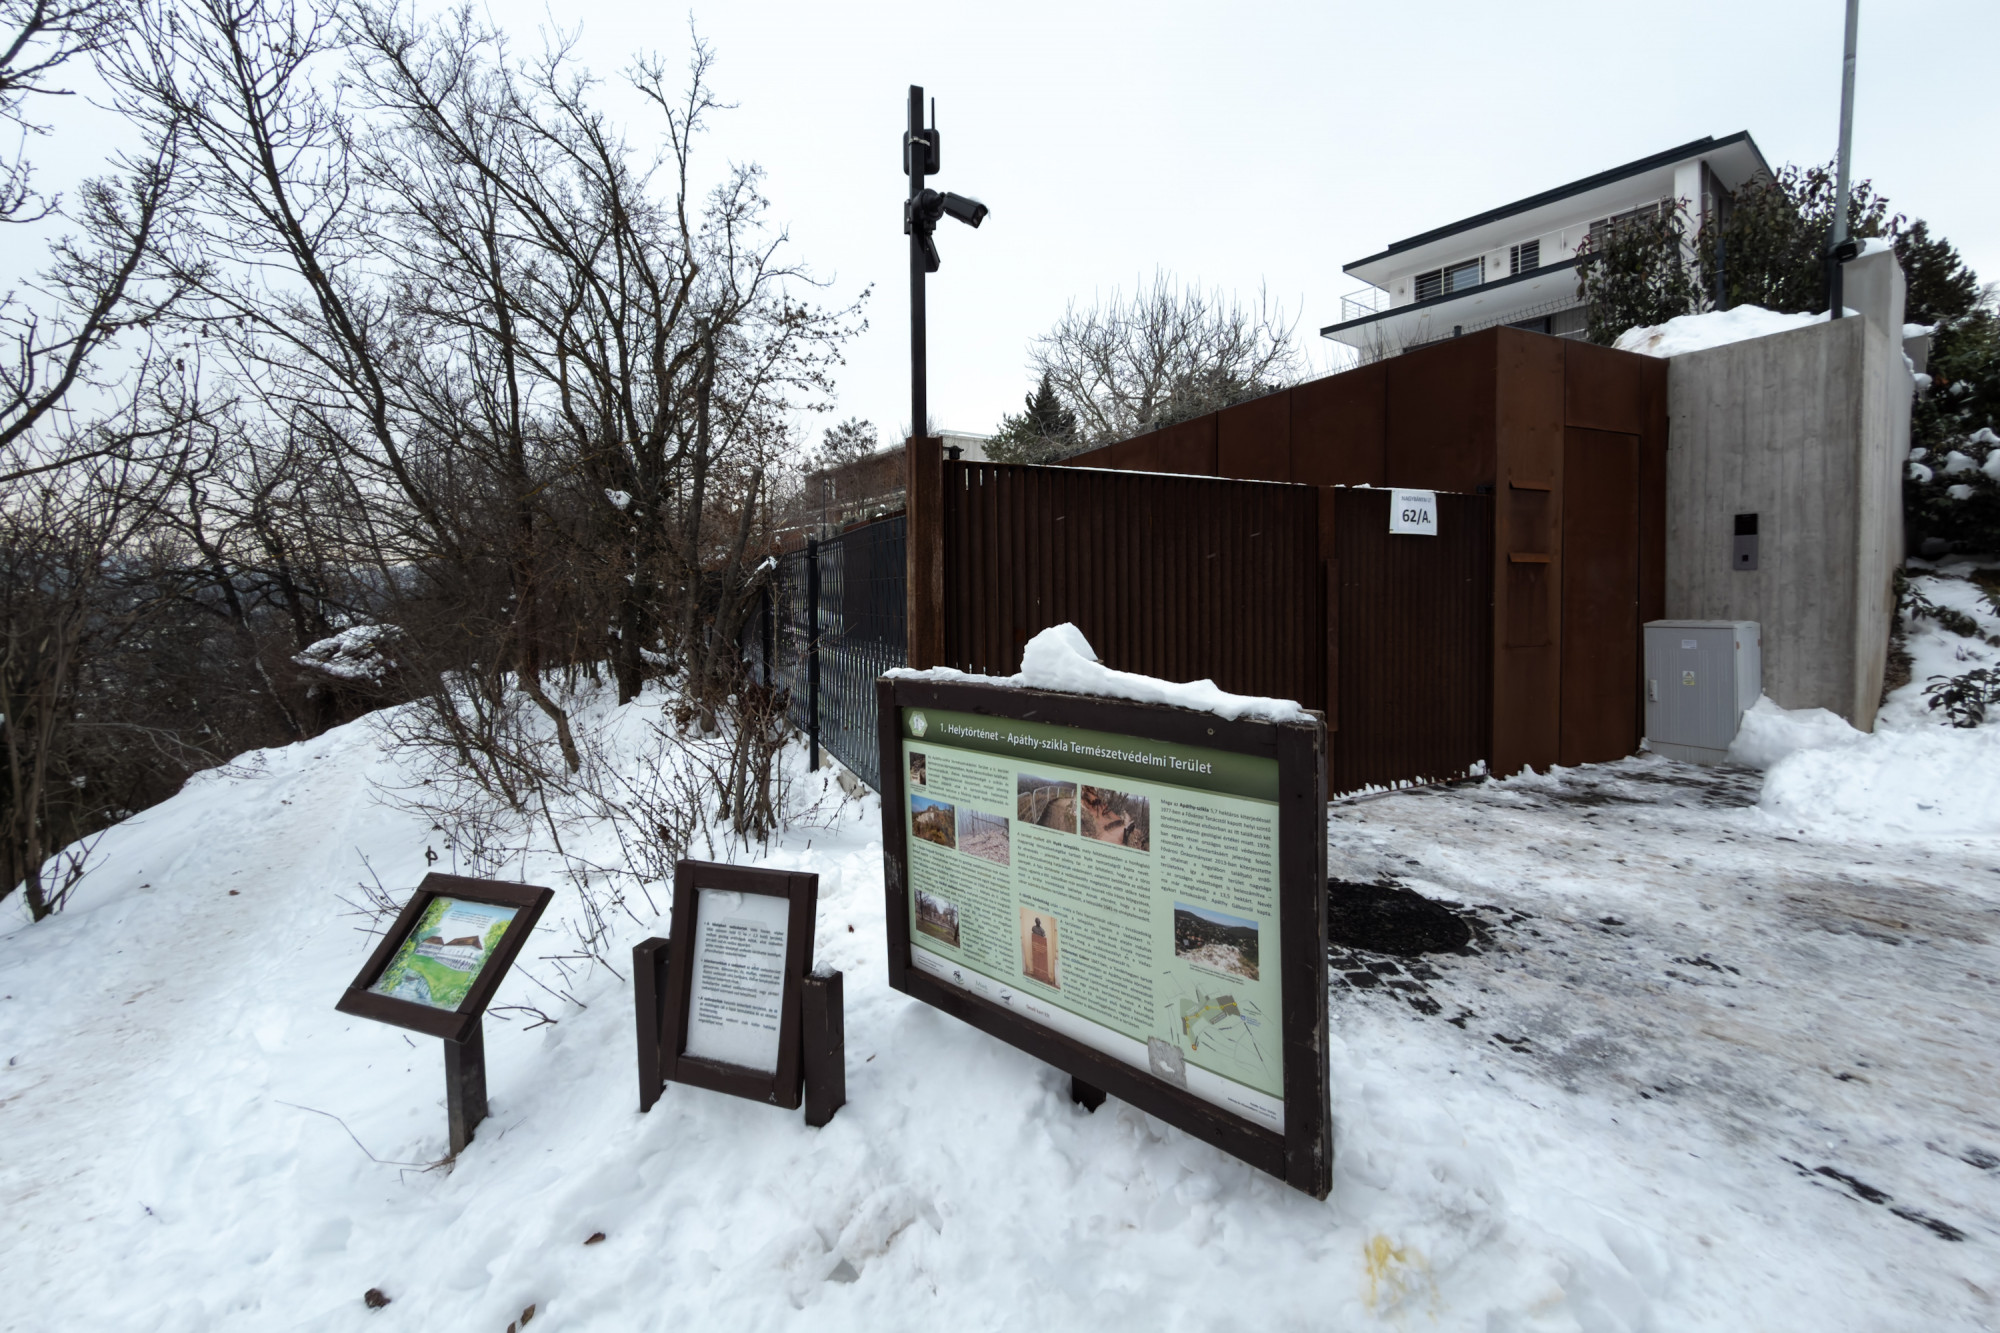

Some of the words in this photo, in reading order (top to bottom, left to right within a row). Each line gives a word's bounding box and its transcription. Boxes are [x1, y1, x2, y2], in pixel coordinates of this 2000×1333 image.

[1402, 508, 1431, 525] 62/A.
[940, 723, 946, 733] 1.
[948, 724, 998, 740] Helytörténet
[1007, 732, 1068, 752] Apáthy-szikla
[1070, 742, 1166, 767] Természetvédelmi
[1169, 756, 1212, 774] Terület
